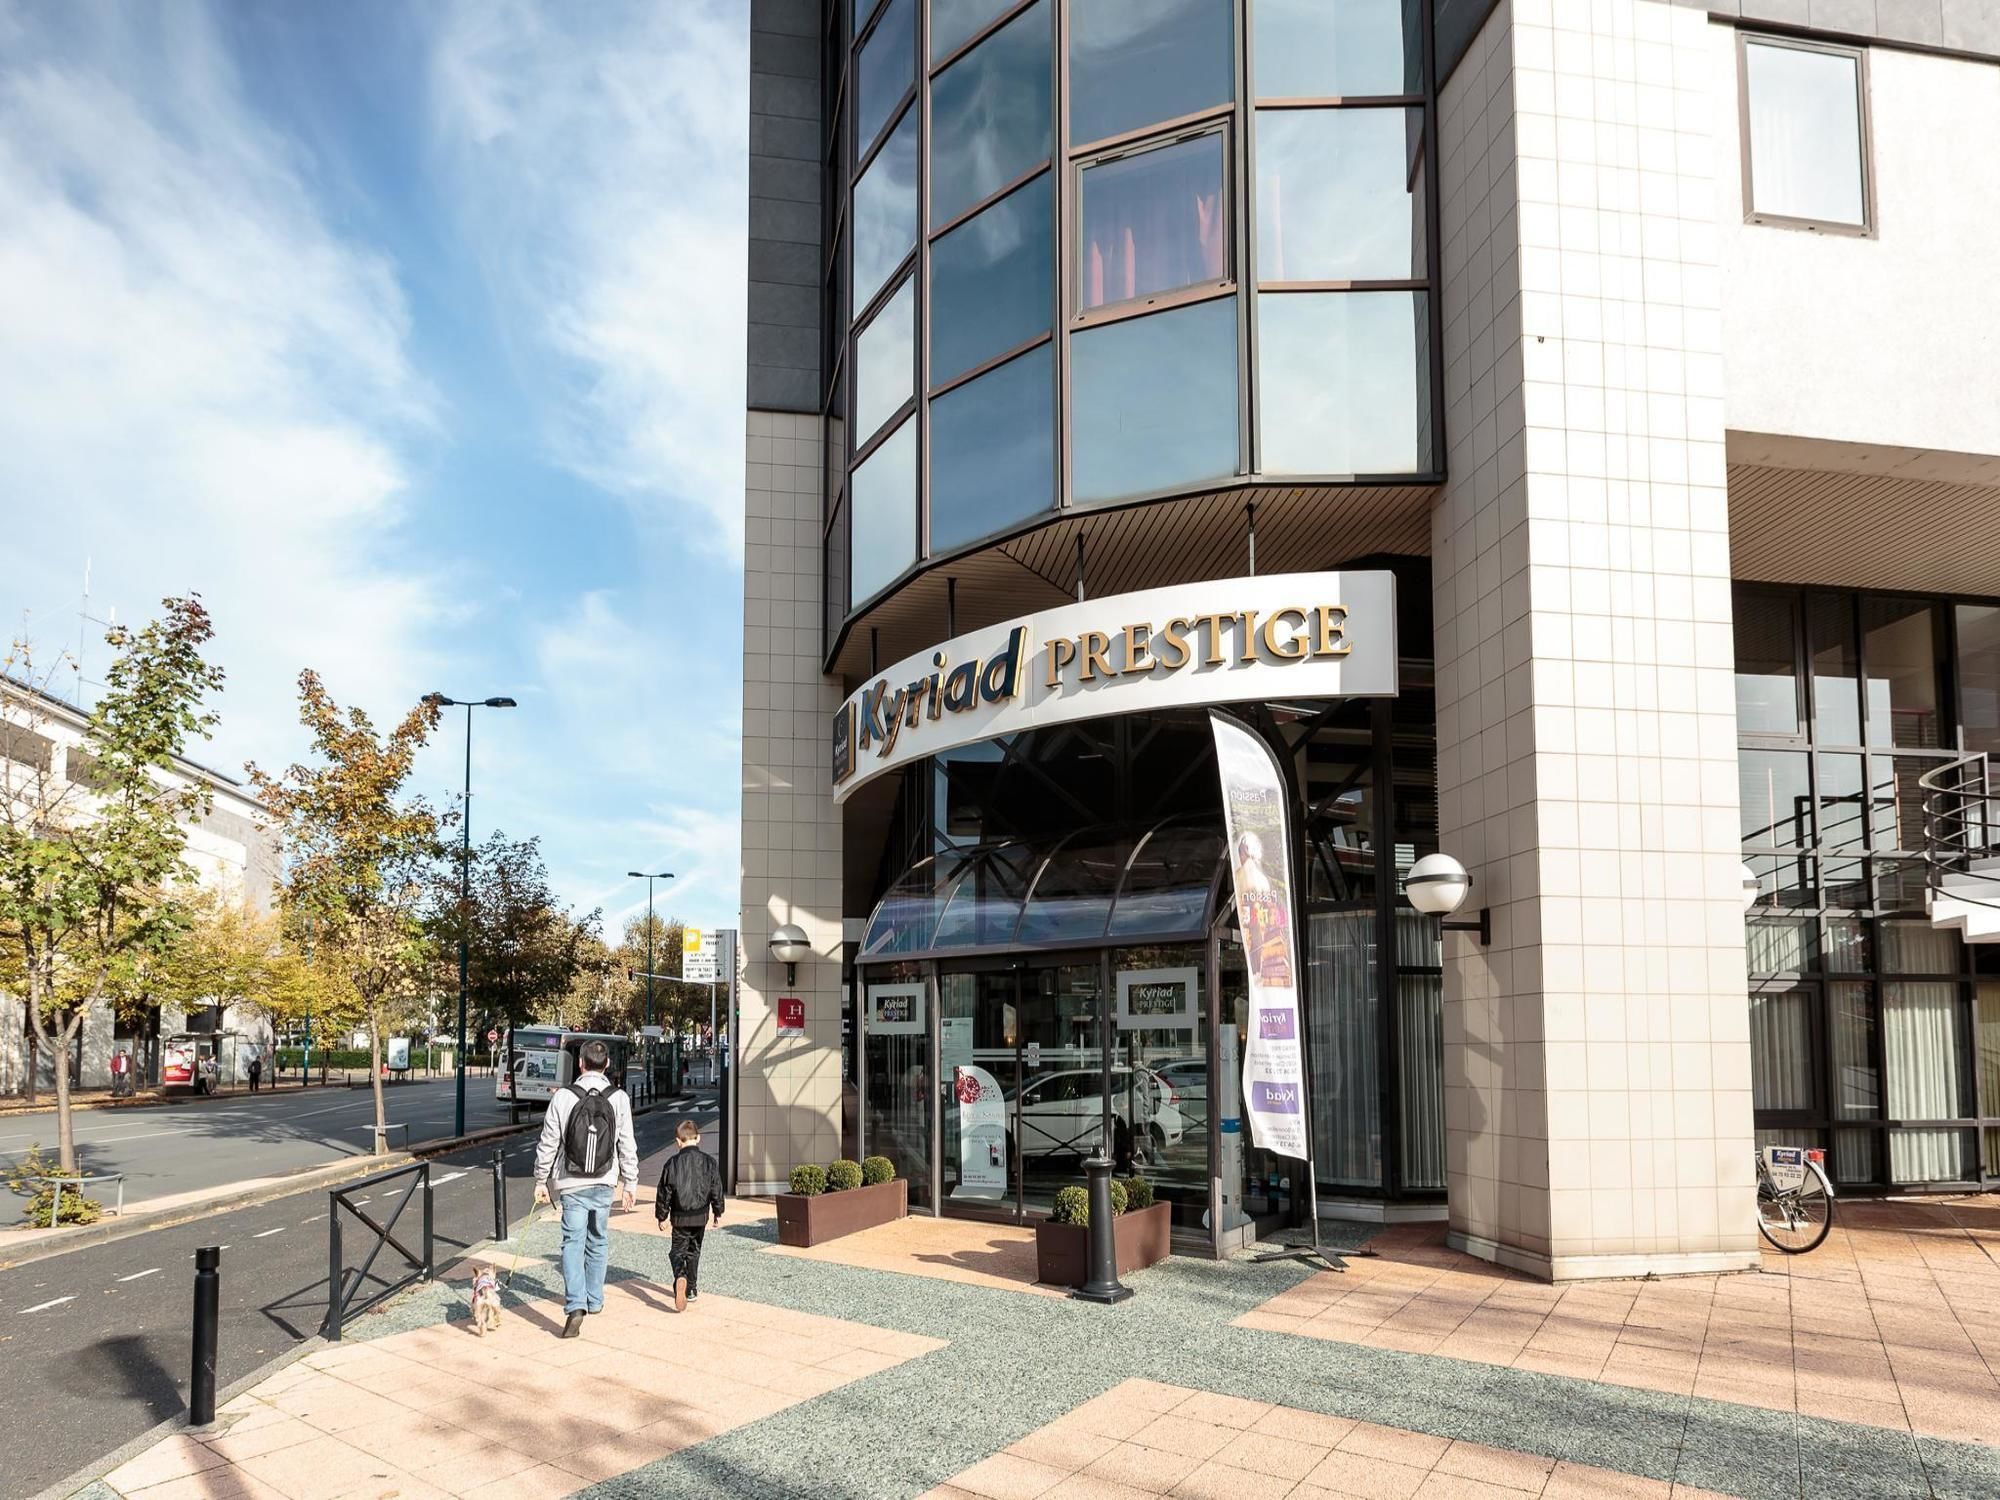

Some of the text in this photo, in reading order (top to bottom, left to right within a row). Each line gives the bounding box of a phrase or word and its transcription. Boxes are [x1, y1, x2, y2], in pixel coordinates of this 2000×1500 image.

[859, 604, 1354, 758] Kyriad PRESTIGE
[1139, 986, 1174, 1001] Kyriad
[790, 1005, 802, 1015] H
[884, 998, 908, 1009] Kyriad
